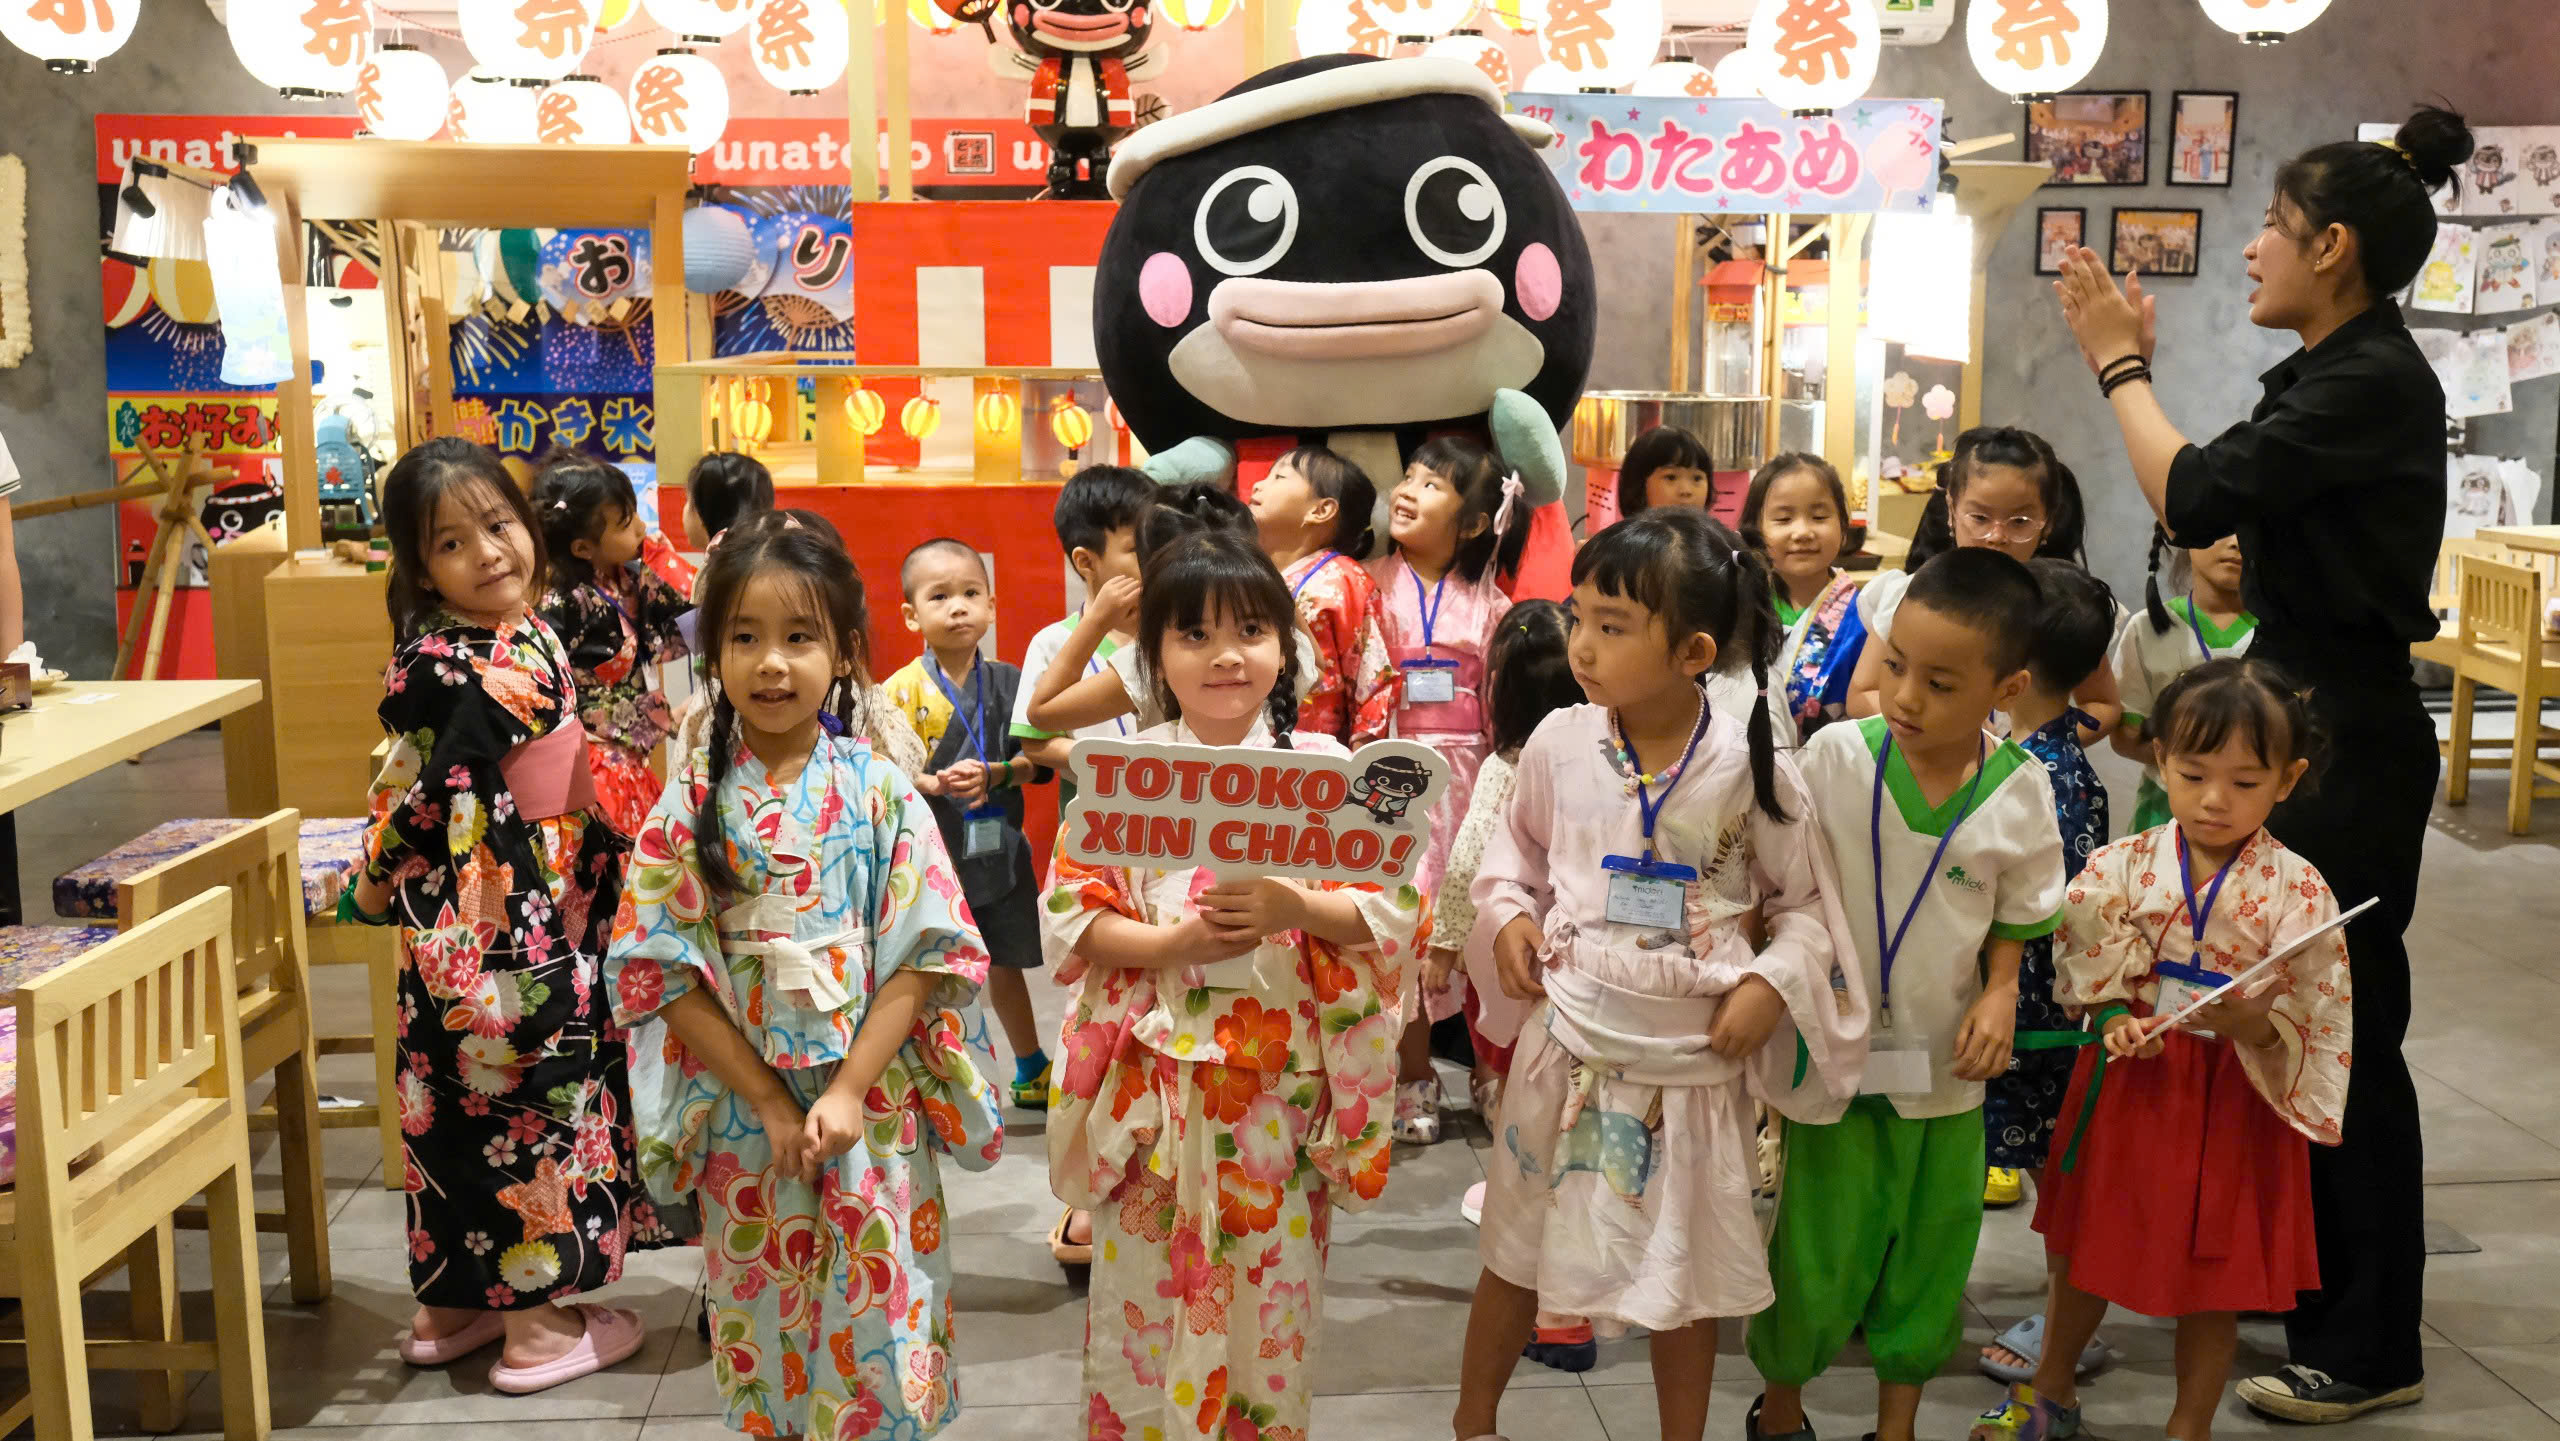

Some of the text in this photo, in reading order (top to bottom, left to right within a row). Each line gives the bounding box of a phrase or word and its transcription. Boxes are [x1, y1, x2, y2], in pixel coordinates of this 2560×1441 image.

[757, 0, 814, 71] 祭
[1544, 0, 1615, 72] 祭
[1773, 0, 1858, 85] 祭
[634, 65, 689, 137] 祭
[713, 131, 932, 171] unato
[1579, 119, 1860, 195] わたあめ
[140, 402, 281, 450] お好み
[492, 396, 656, 454] かき氷
[1086, 753, 1349, 813] TOTOKO
[1080, 809, 1417, 877] XIN CHÀO!
